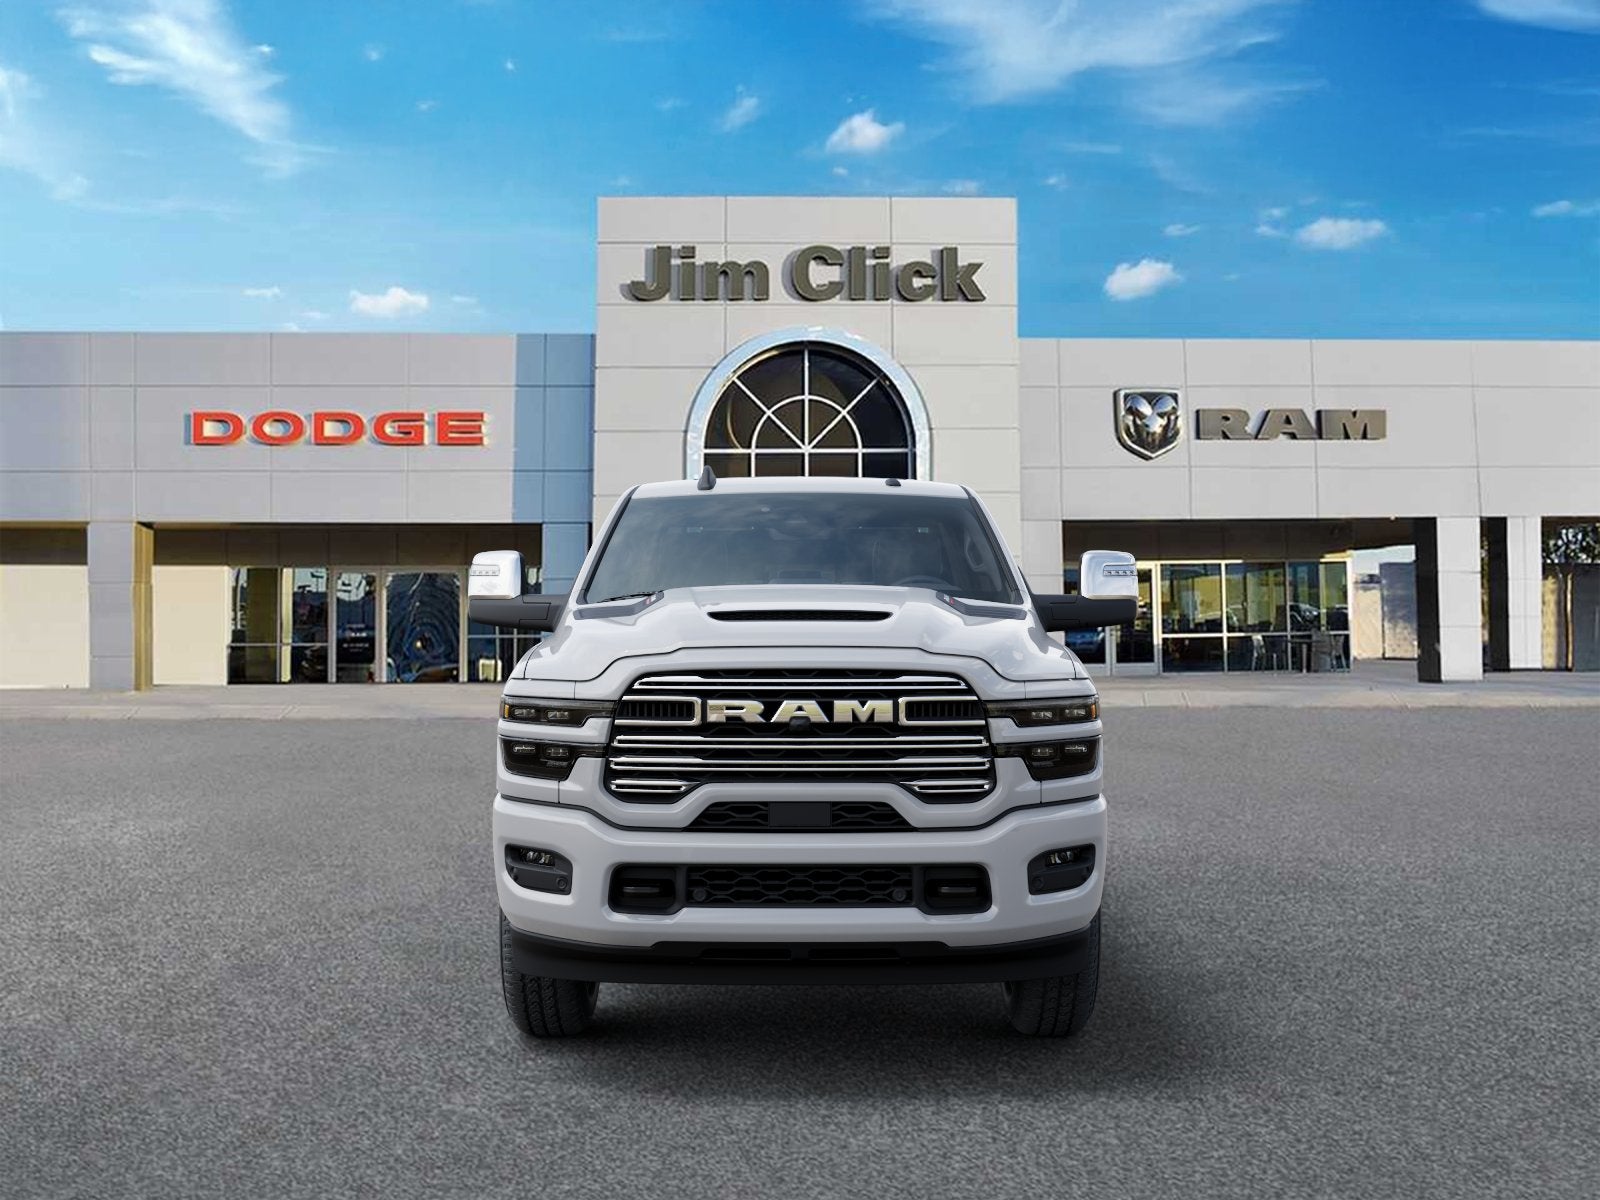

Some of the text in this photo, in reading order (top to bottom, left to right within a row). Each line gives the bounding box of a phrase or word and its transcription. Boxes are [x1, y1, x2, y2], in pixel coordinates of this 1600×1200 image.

[626, 245, 986, 300] Jim Click
[189, 410, 486, 446] DODGE
[1195, 409, 1387, 440] RAM
[706, 700, 894, 722] RAM
